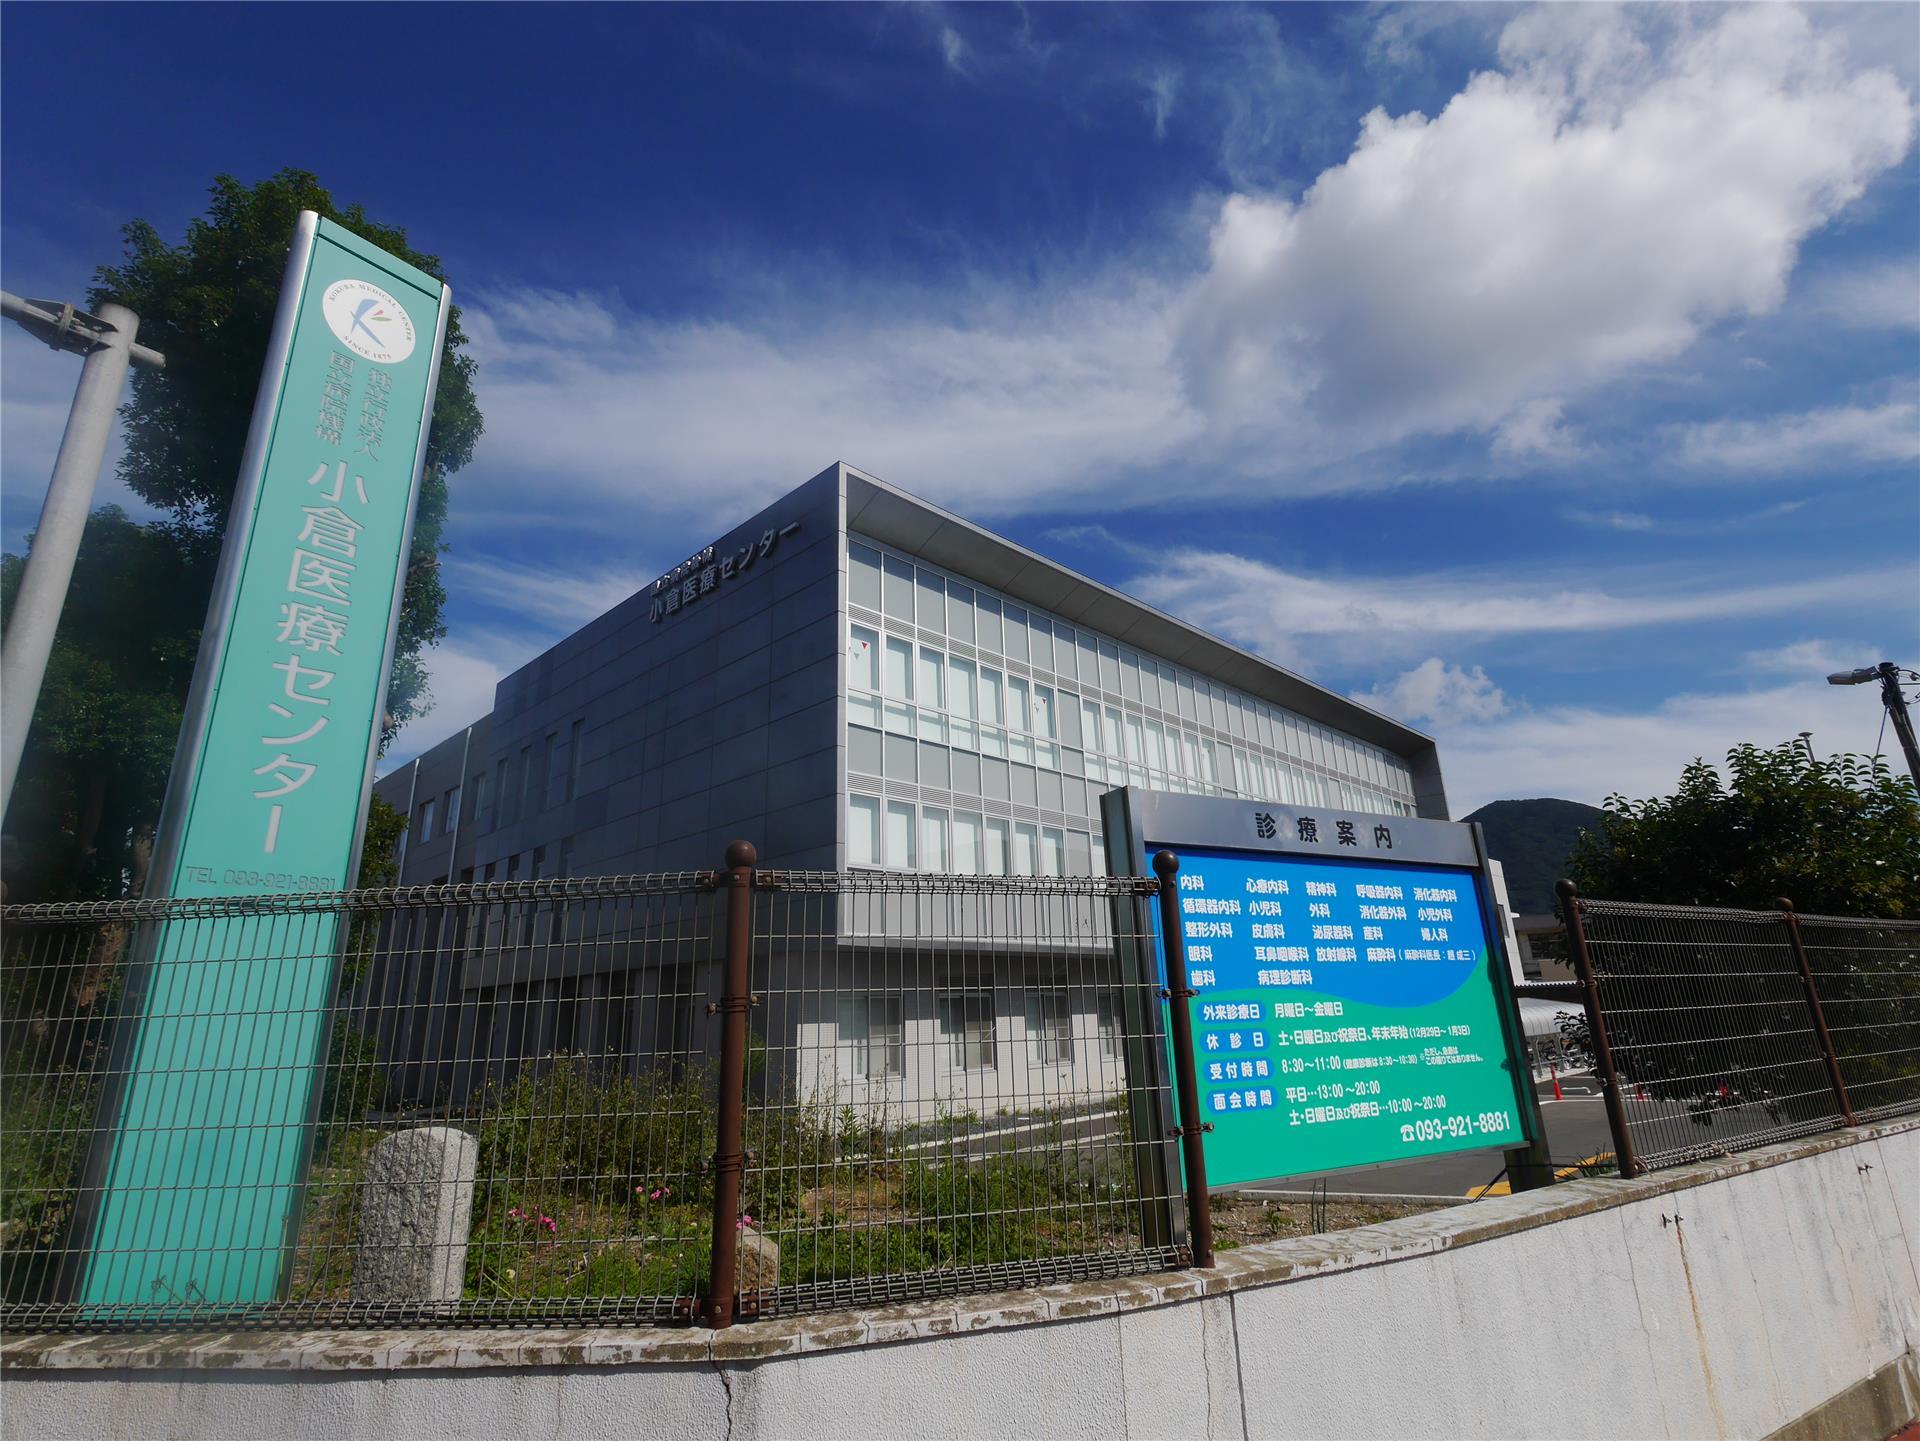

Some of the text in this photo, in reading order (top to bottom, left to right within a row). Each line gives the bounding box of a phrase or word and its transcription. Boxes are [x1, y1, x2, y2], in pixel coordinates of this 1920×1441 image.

[358, 284, 397, 309] MEDICAL
[344, 335, 369, 356] SINCE
[649, 522, 800, 623] 小倉医療センター
[251, 460, 372, 854] 小倉医療センター
[1254, 812, 1393, 850] 診療案内
[185, 866, 217, 884] TEL
[1181, 875, 1456, 902] 内科 心療内科 精神科 呼吸器内科 消化器内科
[1183, 898, 1452, 921] 循環器内科 小児科 外科 消化器外科 小児外科
[1185, 922, 1448, 941] 整形外科 皮膚科 泌尿器科 産科 婦人科
[1188, 946, 1212, 961] 眼科
[1255, 947, 1309, 961] 耳鼻咽喉科
[1316, 947, 1356, 961] 放射線科
[1191, 970, 1312, 986] 歯科 病理診断科
[1204, 1004, 1259, 1020] 外来診療日
[1416, 1112, 1509, 1141] 093-921-8881
